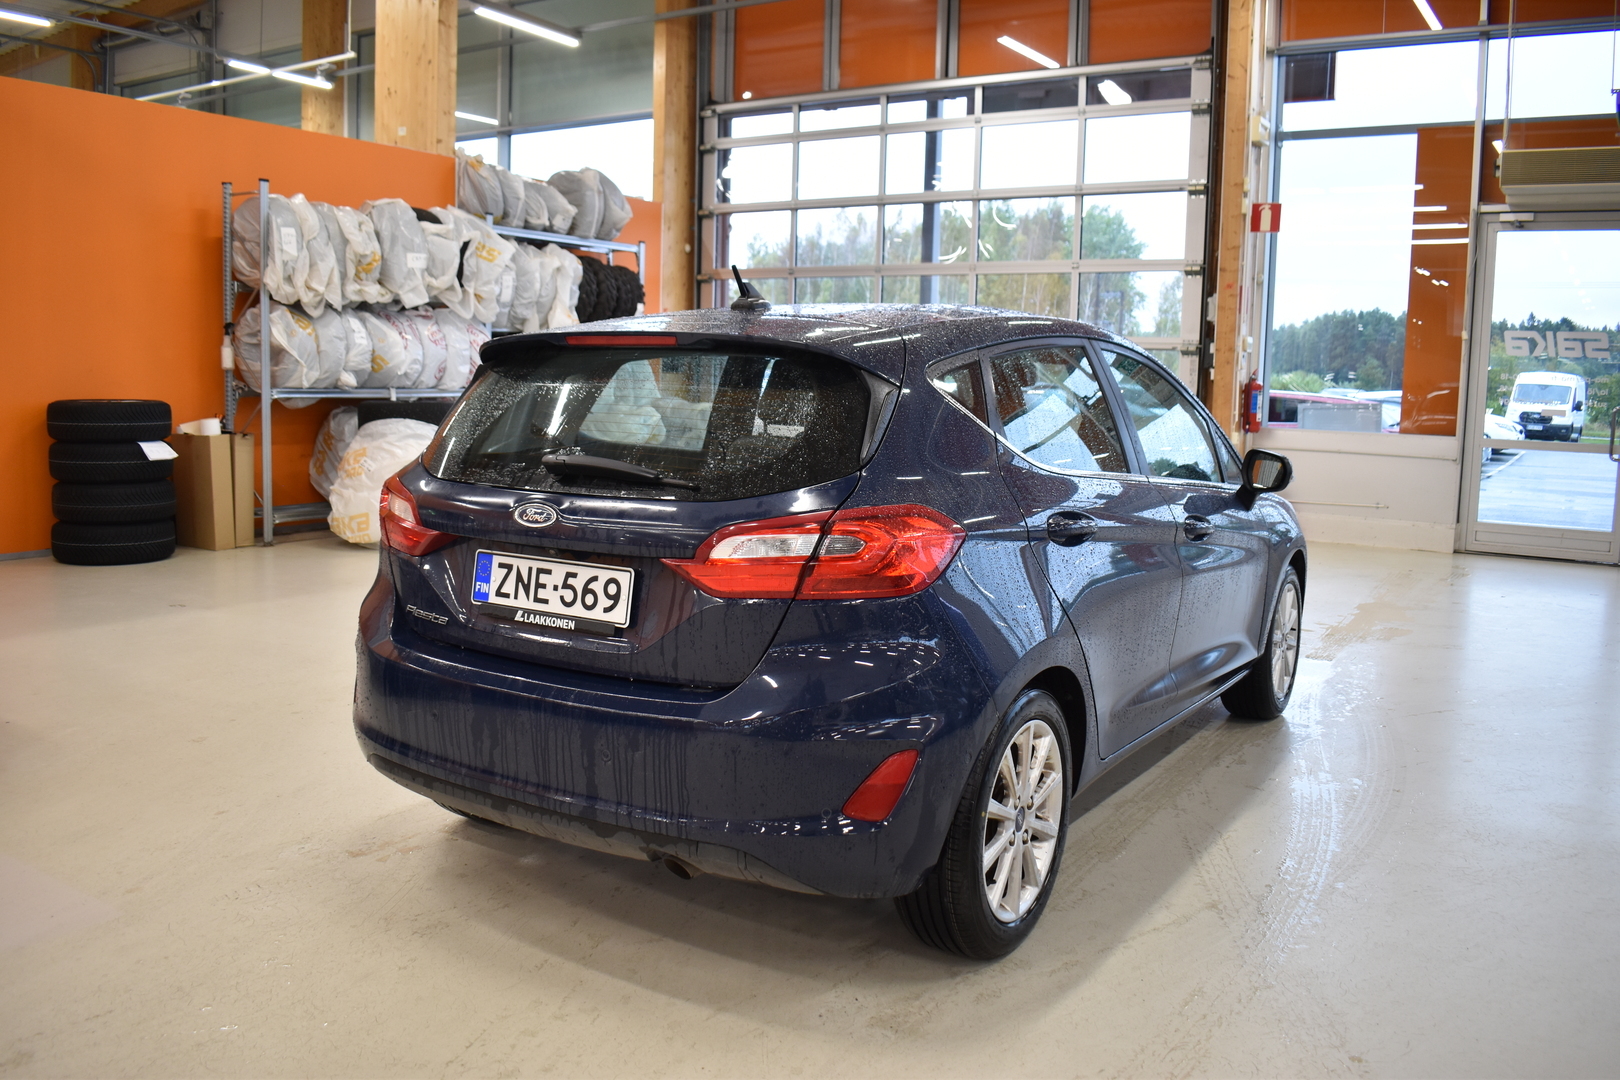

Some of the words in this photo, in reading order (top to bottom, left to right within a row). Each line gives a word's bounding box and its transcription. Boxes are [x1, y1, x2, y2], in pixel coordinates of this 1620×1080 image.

[522, 508, 549, 522] Ford
[475, 581, 489, 594] FIN
[495, 561, 622, 613] ZNE-569
[405, 604, 449, 626] Fiesta
[523, 611, 575, 630] LAAKKONEN
